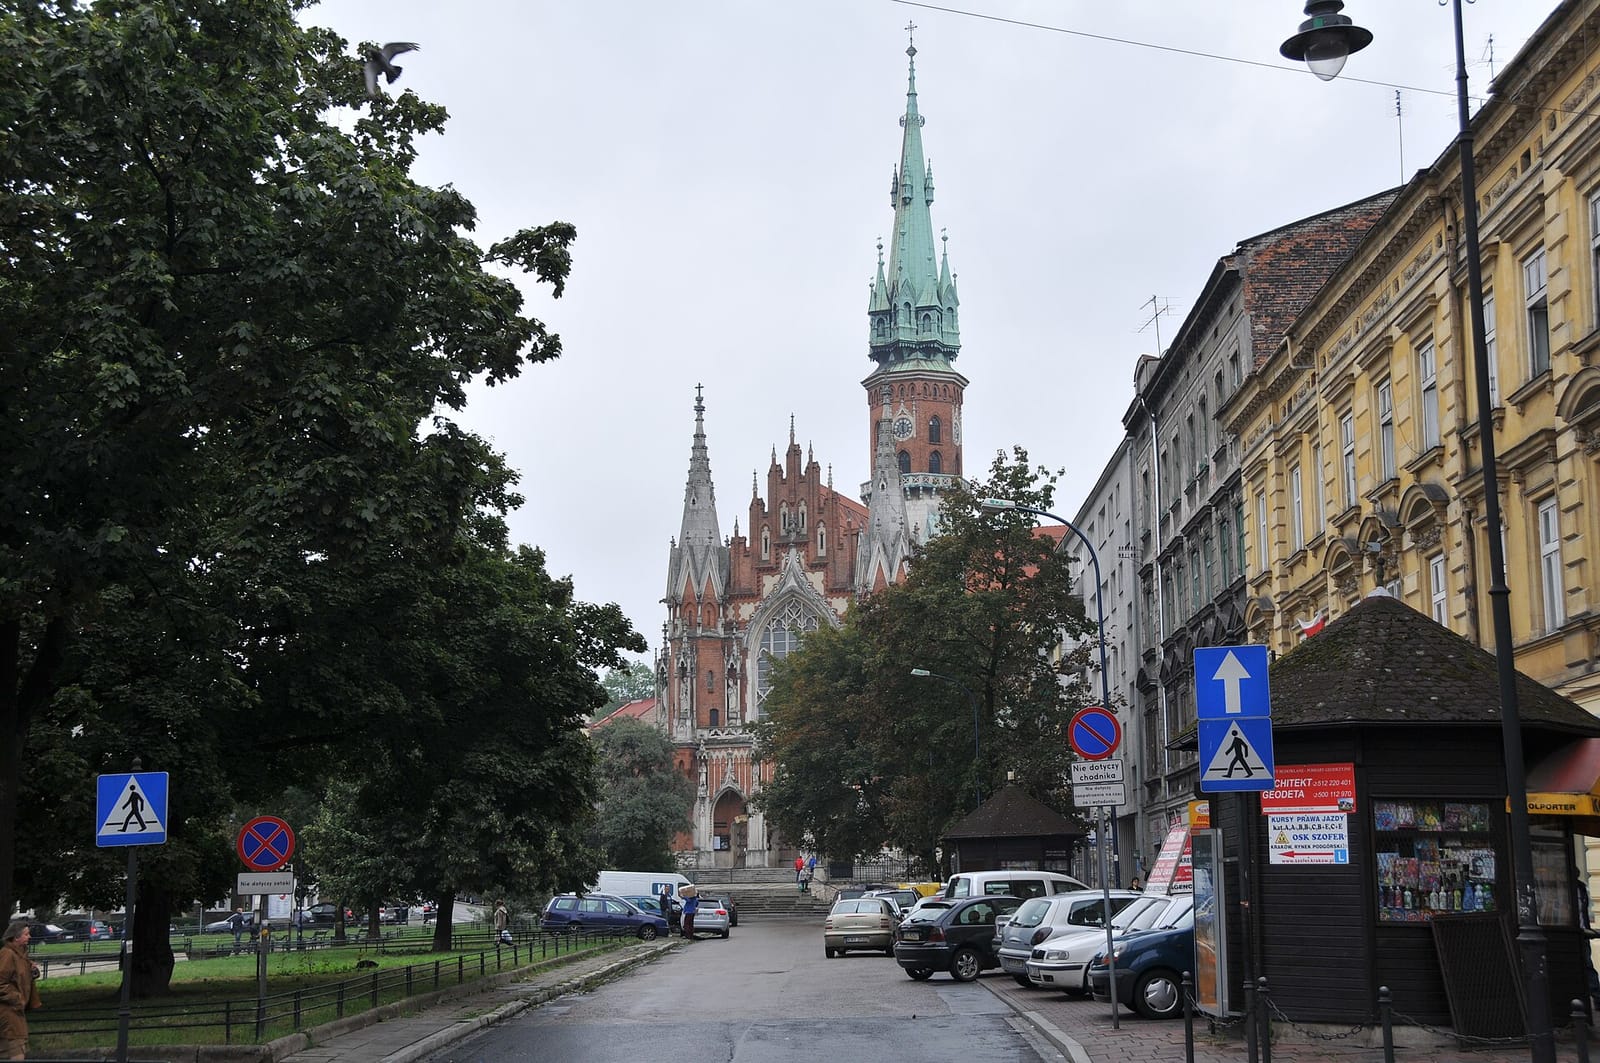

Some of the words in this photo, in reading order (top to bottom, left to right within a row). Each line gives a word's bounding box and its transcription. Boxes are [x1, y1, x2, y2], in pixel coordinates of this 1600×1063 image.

[1089, 763, 1119, 771] dotyczy
[1079, 773, 1116, 781] chodnika
[1262, 790, 1305, 799] GEODETA
[1338, 852, 1345, 862] L
